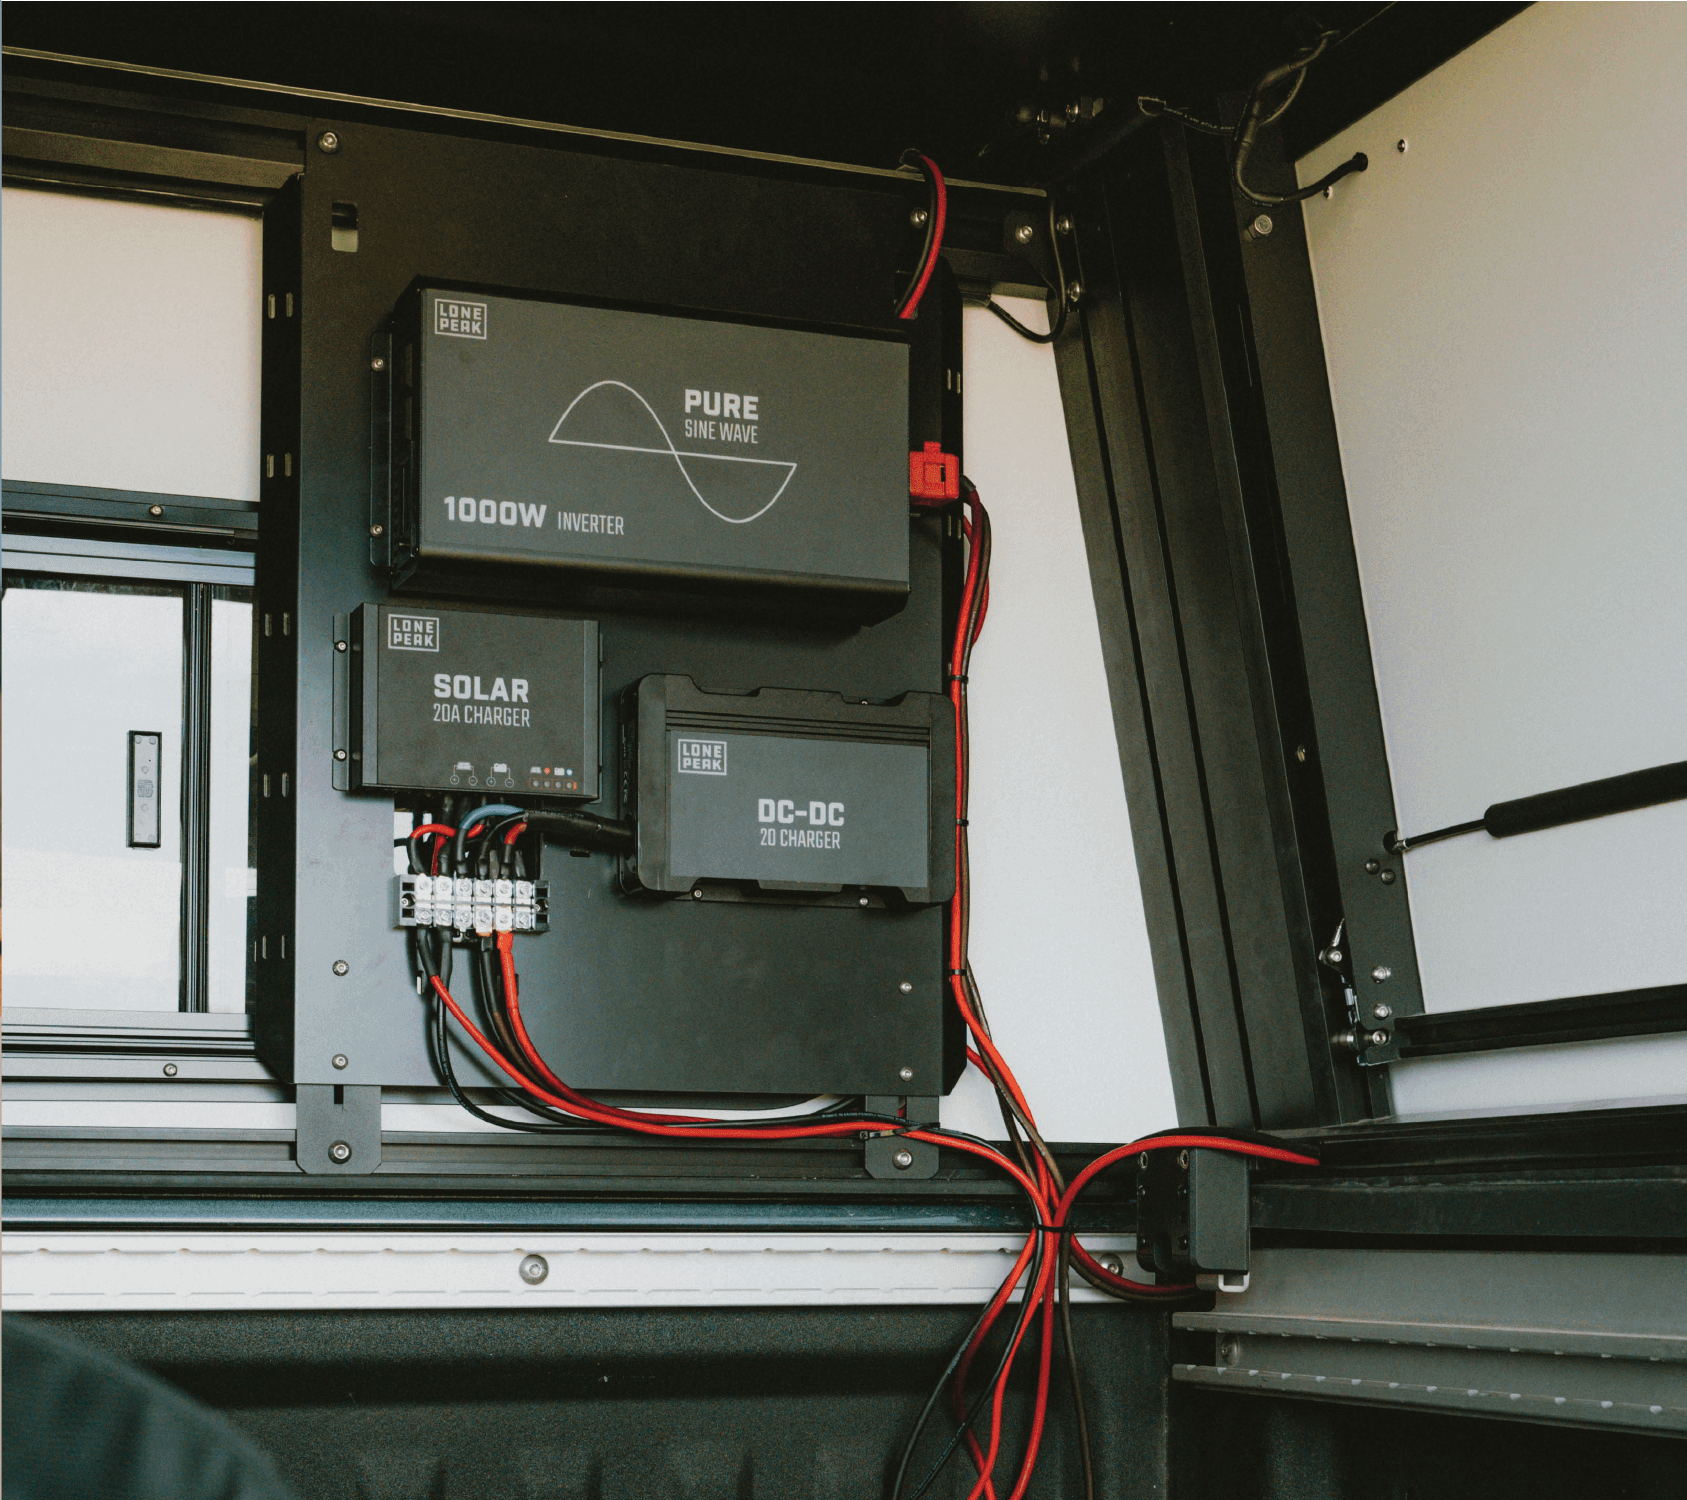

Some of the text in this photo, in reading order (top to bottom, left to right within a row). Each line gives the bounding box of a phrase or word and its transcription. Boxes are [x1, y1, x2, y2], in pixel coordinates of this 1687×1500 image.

[439, 304, 483, 322] LONE
[439, 318, 484, 336] PEAK
[685, 389, 759, 421] PURE
[685, 419, 759, 444] SINE WAVE
[443, 496, 625, 536] 1000W INVERTER
[393, 618, 434, 635] LONE
[393, 632, 435, 648] PEAK
[433, 674, 529, 703] SOLAR
[433, 703, 530, 728] 20A CHARGER
[682, 743, 723, 760] LONE
[682, 756, 723, 772] PEAK
[758, 798, 845, 828] DC-DC
[760, 827, 841, 850] 20 CHARGER
